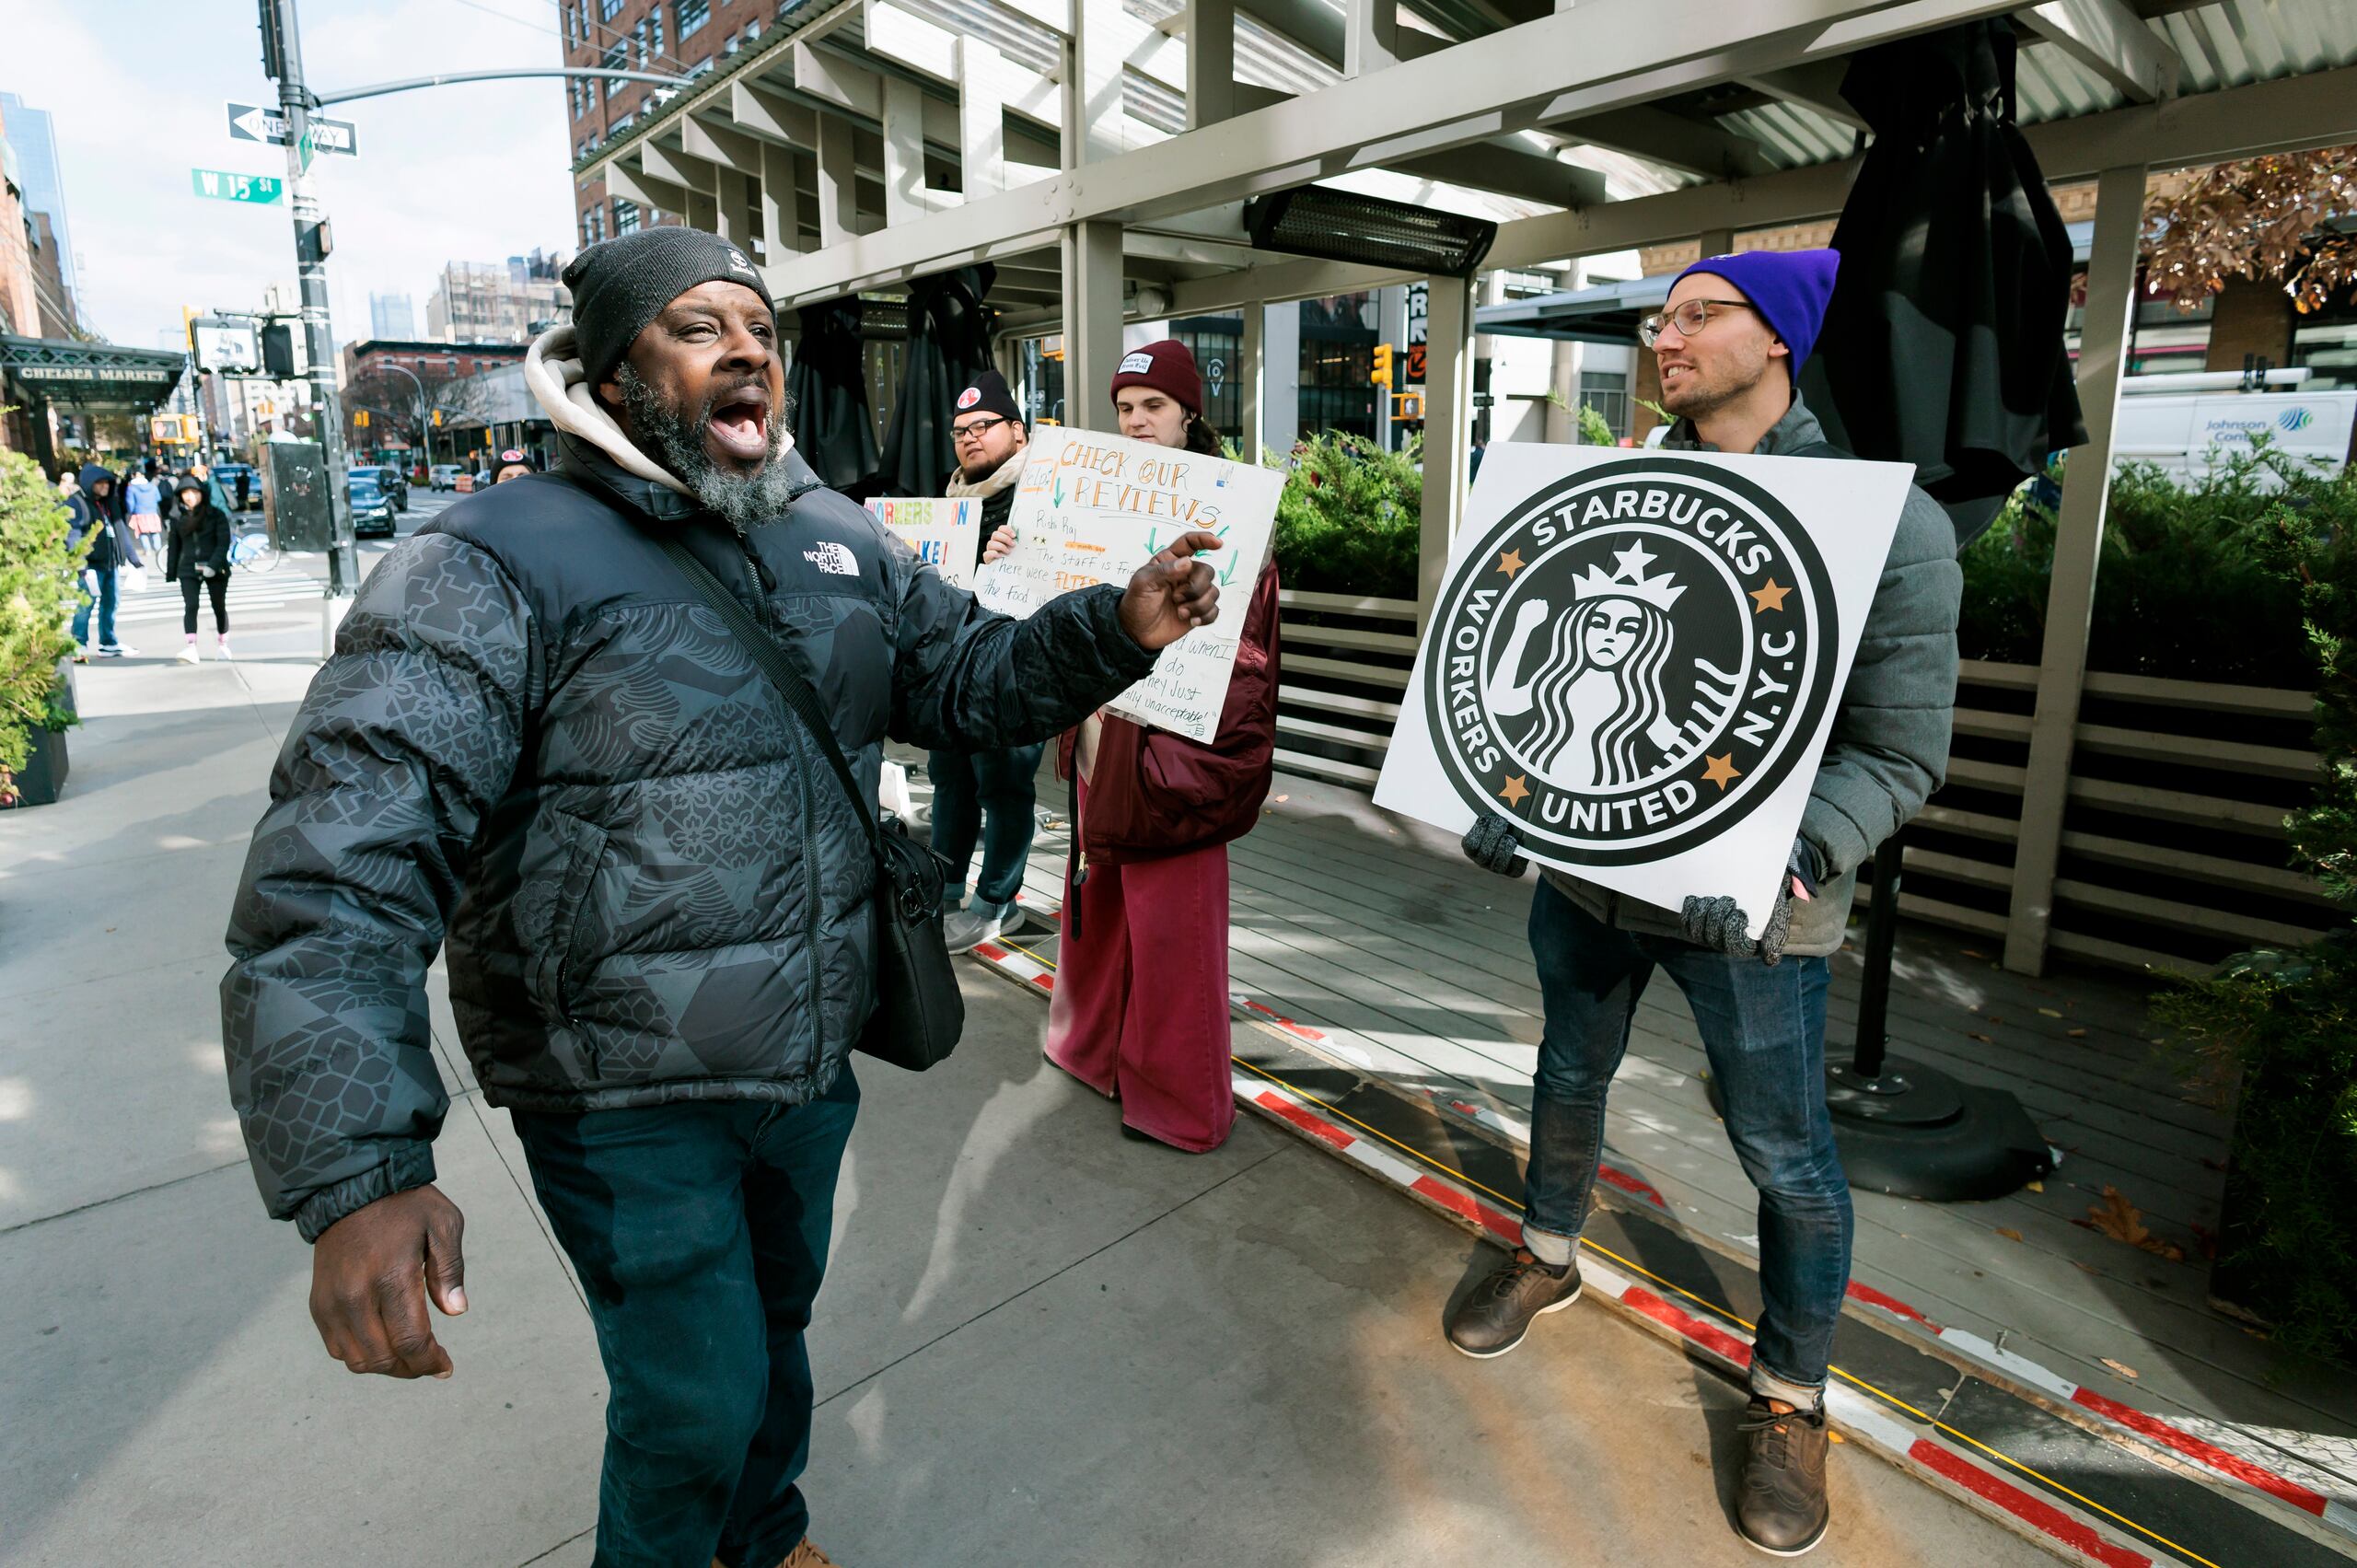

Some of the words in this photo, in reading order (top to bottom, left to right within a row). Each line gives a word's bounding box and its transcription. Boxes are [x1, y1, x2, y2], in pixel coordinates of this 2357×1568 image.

[249, 117, 285, 134] ONE
[201, 171, 218, 196] W
[226, 175, 250, 199] 15
[259, 178, 273, 192] St
[20, 366, 93, 380] CHELSEA
[99, 369, 167, 382] MARKET
[2205, 419, 2267, 431] Johnson
[2213, 430, 2276, 442] Conts
[1061, 440, 1132, 478] CHECK
[1138, 459, 1190, 491] OUR
[1074, 476, 1222, 529] REVIEWS
[950, 500, 970, 527] ON
[1531, 489, 1772, 575] STARBUCKS
[803, 551, 841, 564] NORTH
[816, 541, 839, 553] THE
[817, 562, 844, 575] FACE
[1027, 568, 1049, 582] were
[984, 577, 1001, 598] the
[1165, 656, 1185, 677] do
[1450, 589, 1502, 773] WORKERS
[1732, 630, 1796, 748] N.Y.C
[1541, 779, 1697, 832] UNITED
